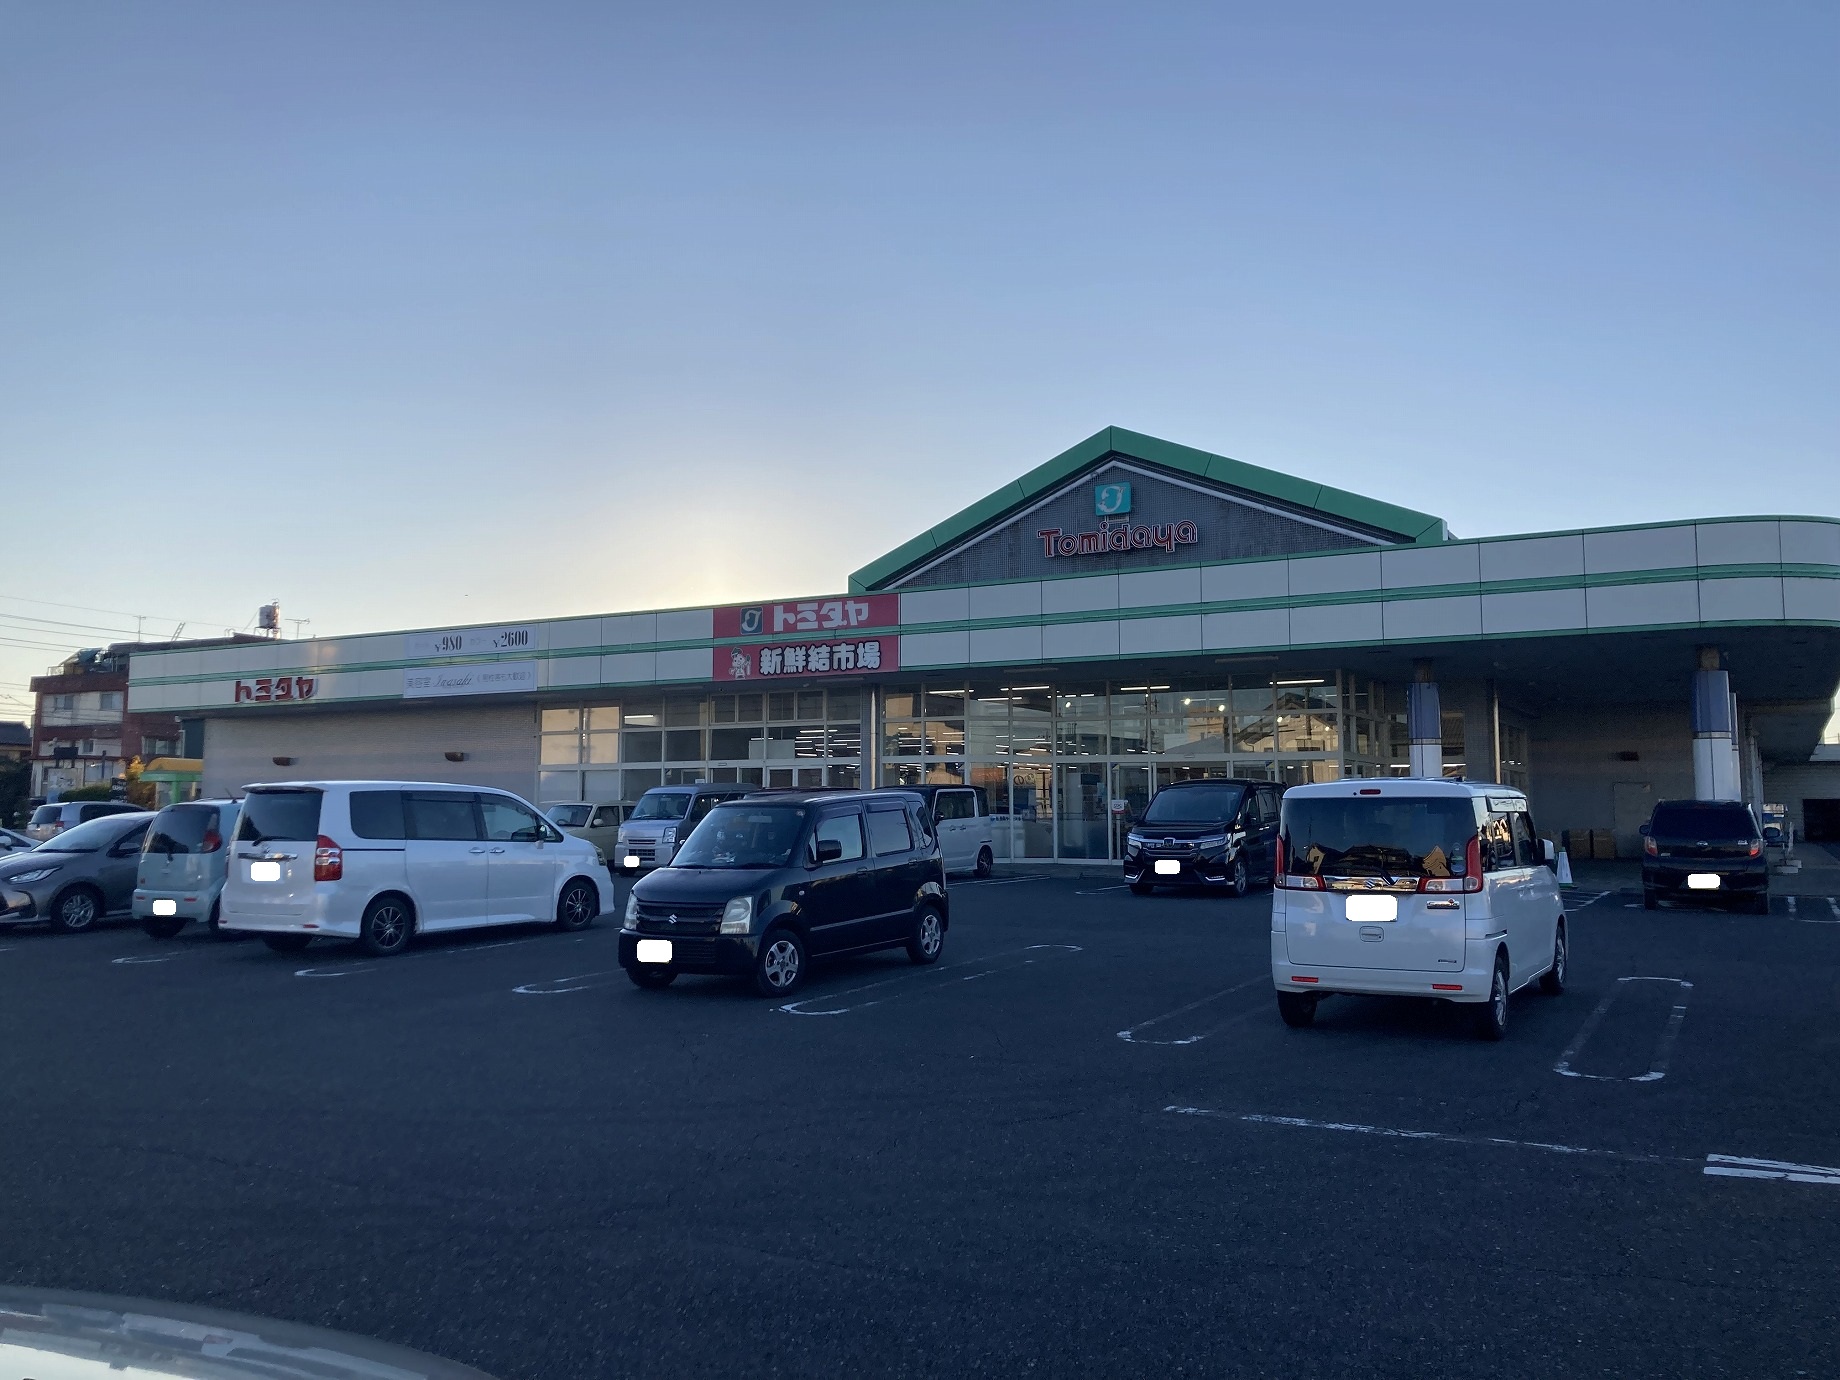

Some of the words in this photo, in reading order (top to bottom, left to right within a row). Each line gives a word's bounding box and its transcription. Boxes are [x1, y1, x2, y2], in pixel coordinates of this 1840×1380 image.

[1037, 520, 1197, 557] Tomidaya
[759, 641, 881, 675] 新鮮結市場
